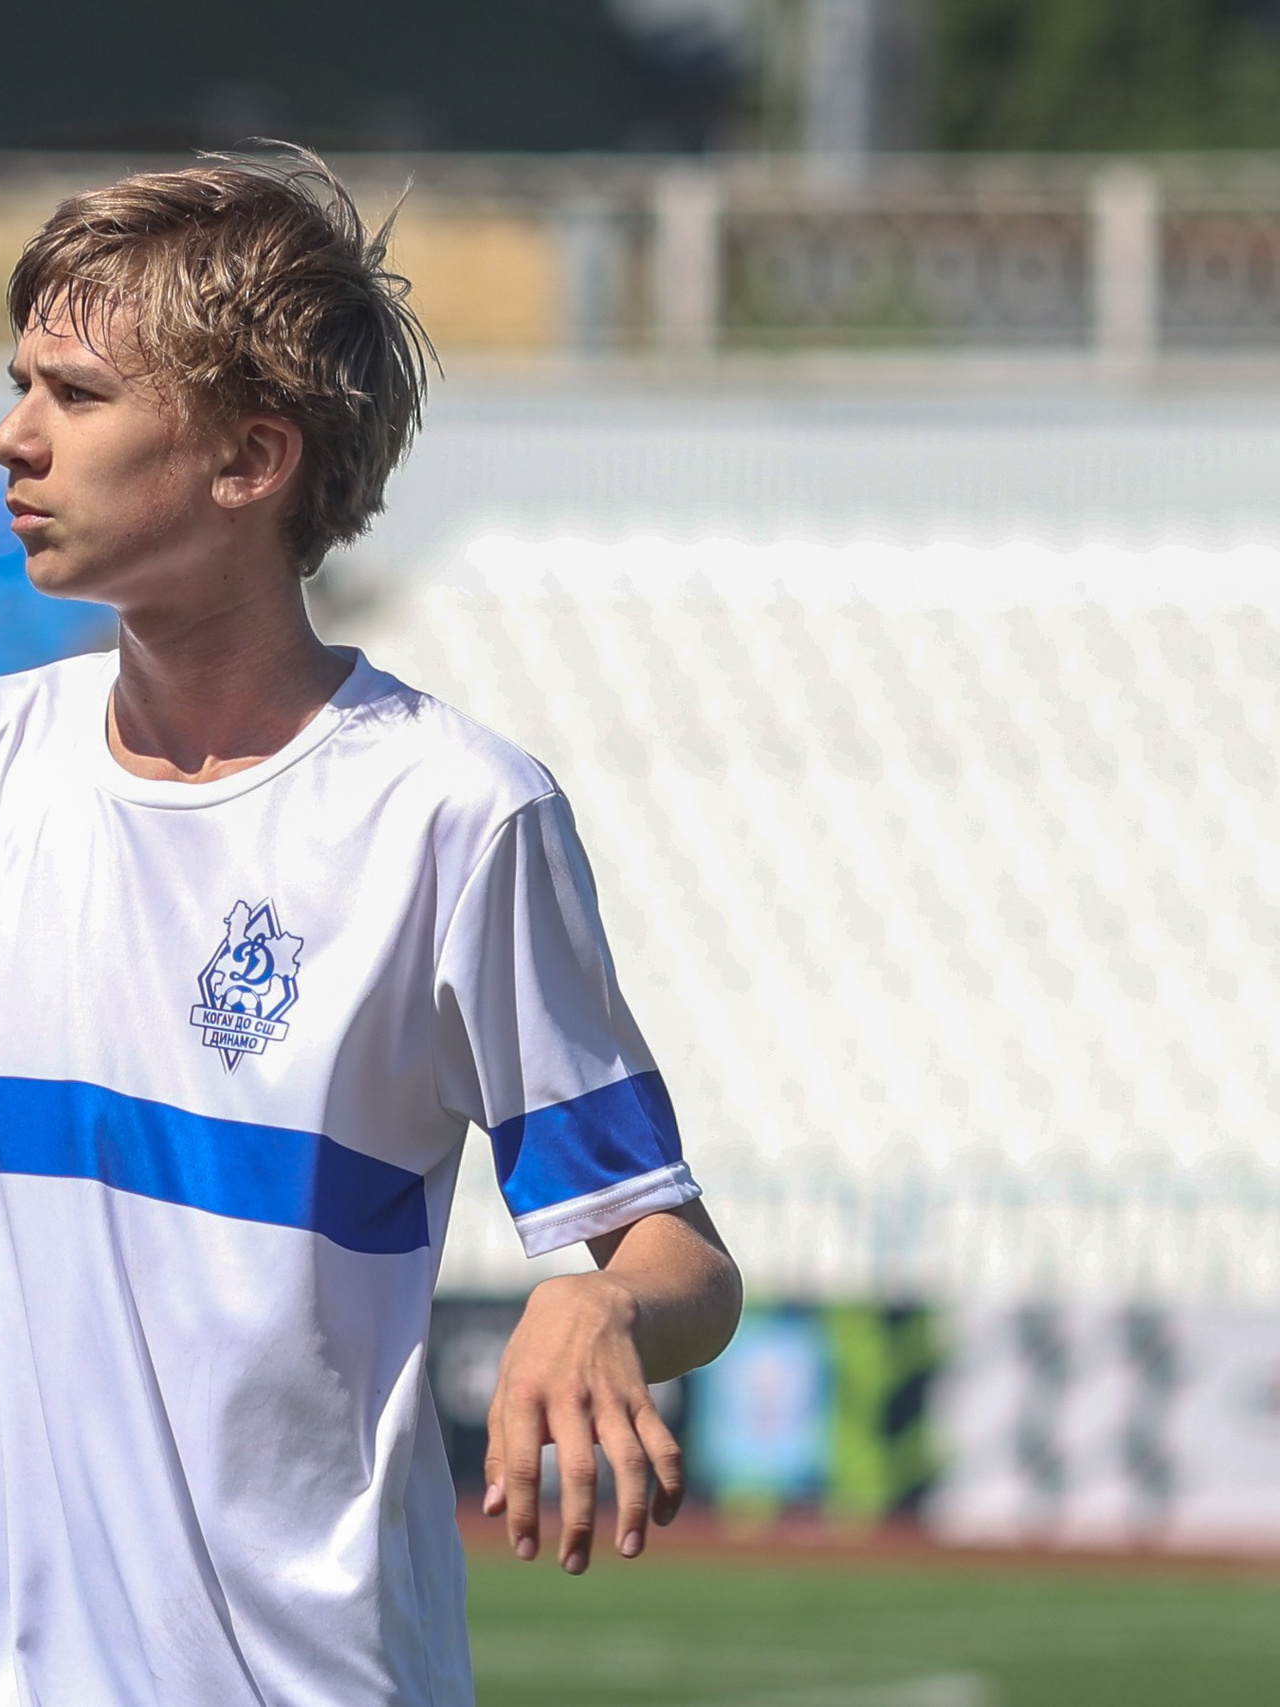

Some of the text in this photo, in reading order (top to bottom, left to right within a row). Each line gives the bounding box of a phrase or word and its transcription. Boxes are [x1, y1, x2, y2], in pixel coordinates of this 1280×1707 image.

[202, 1011, 276, 1036] КОГАУ ДО СШ
[210, 1031, 258, 1050] ДИНАМО
